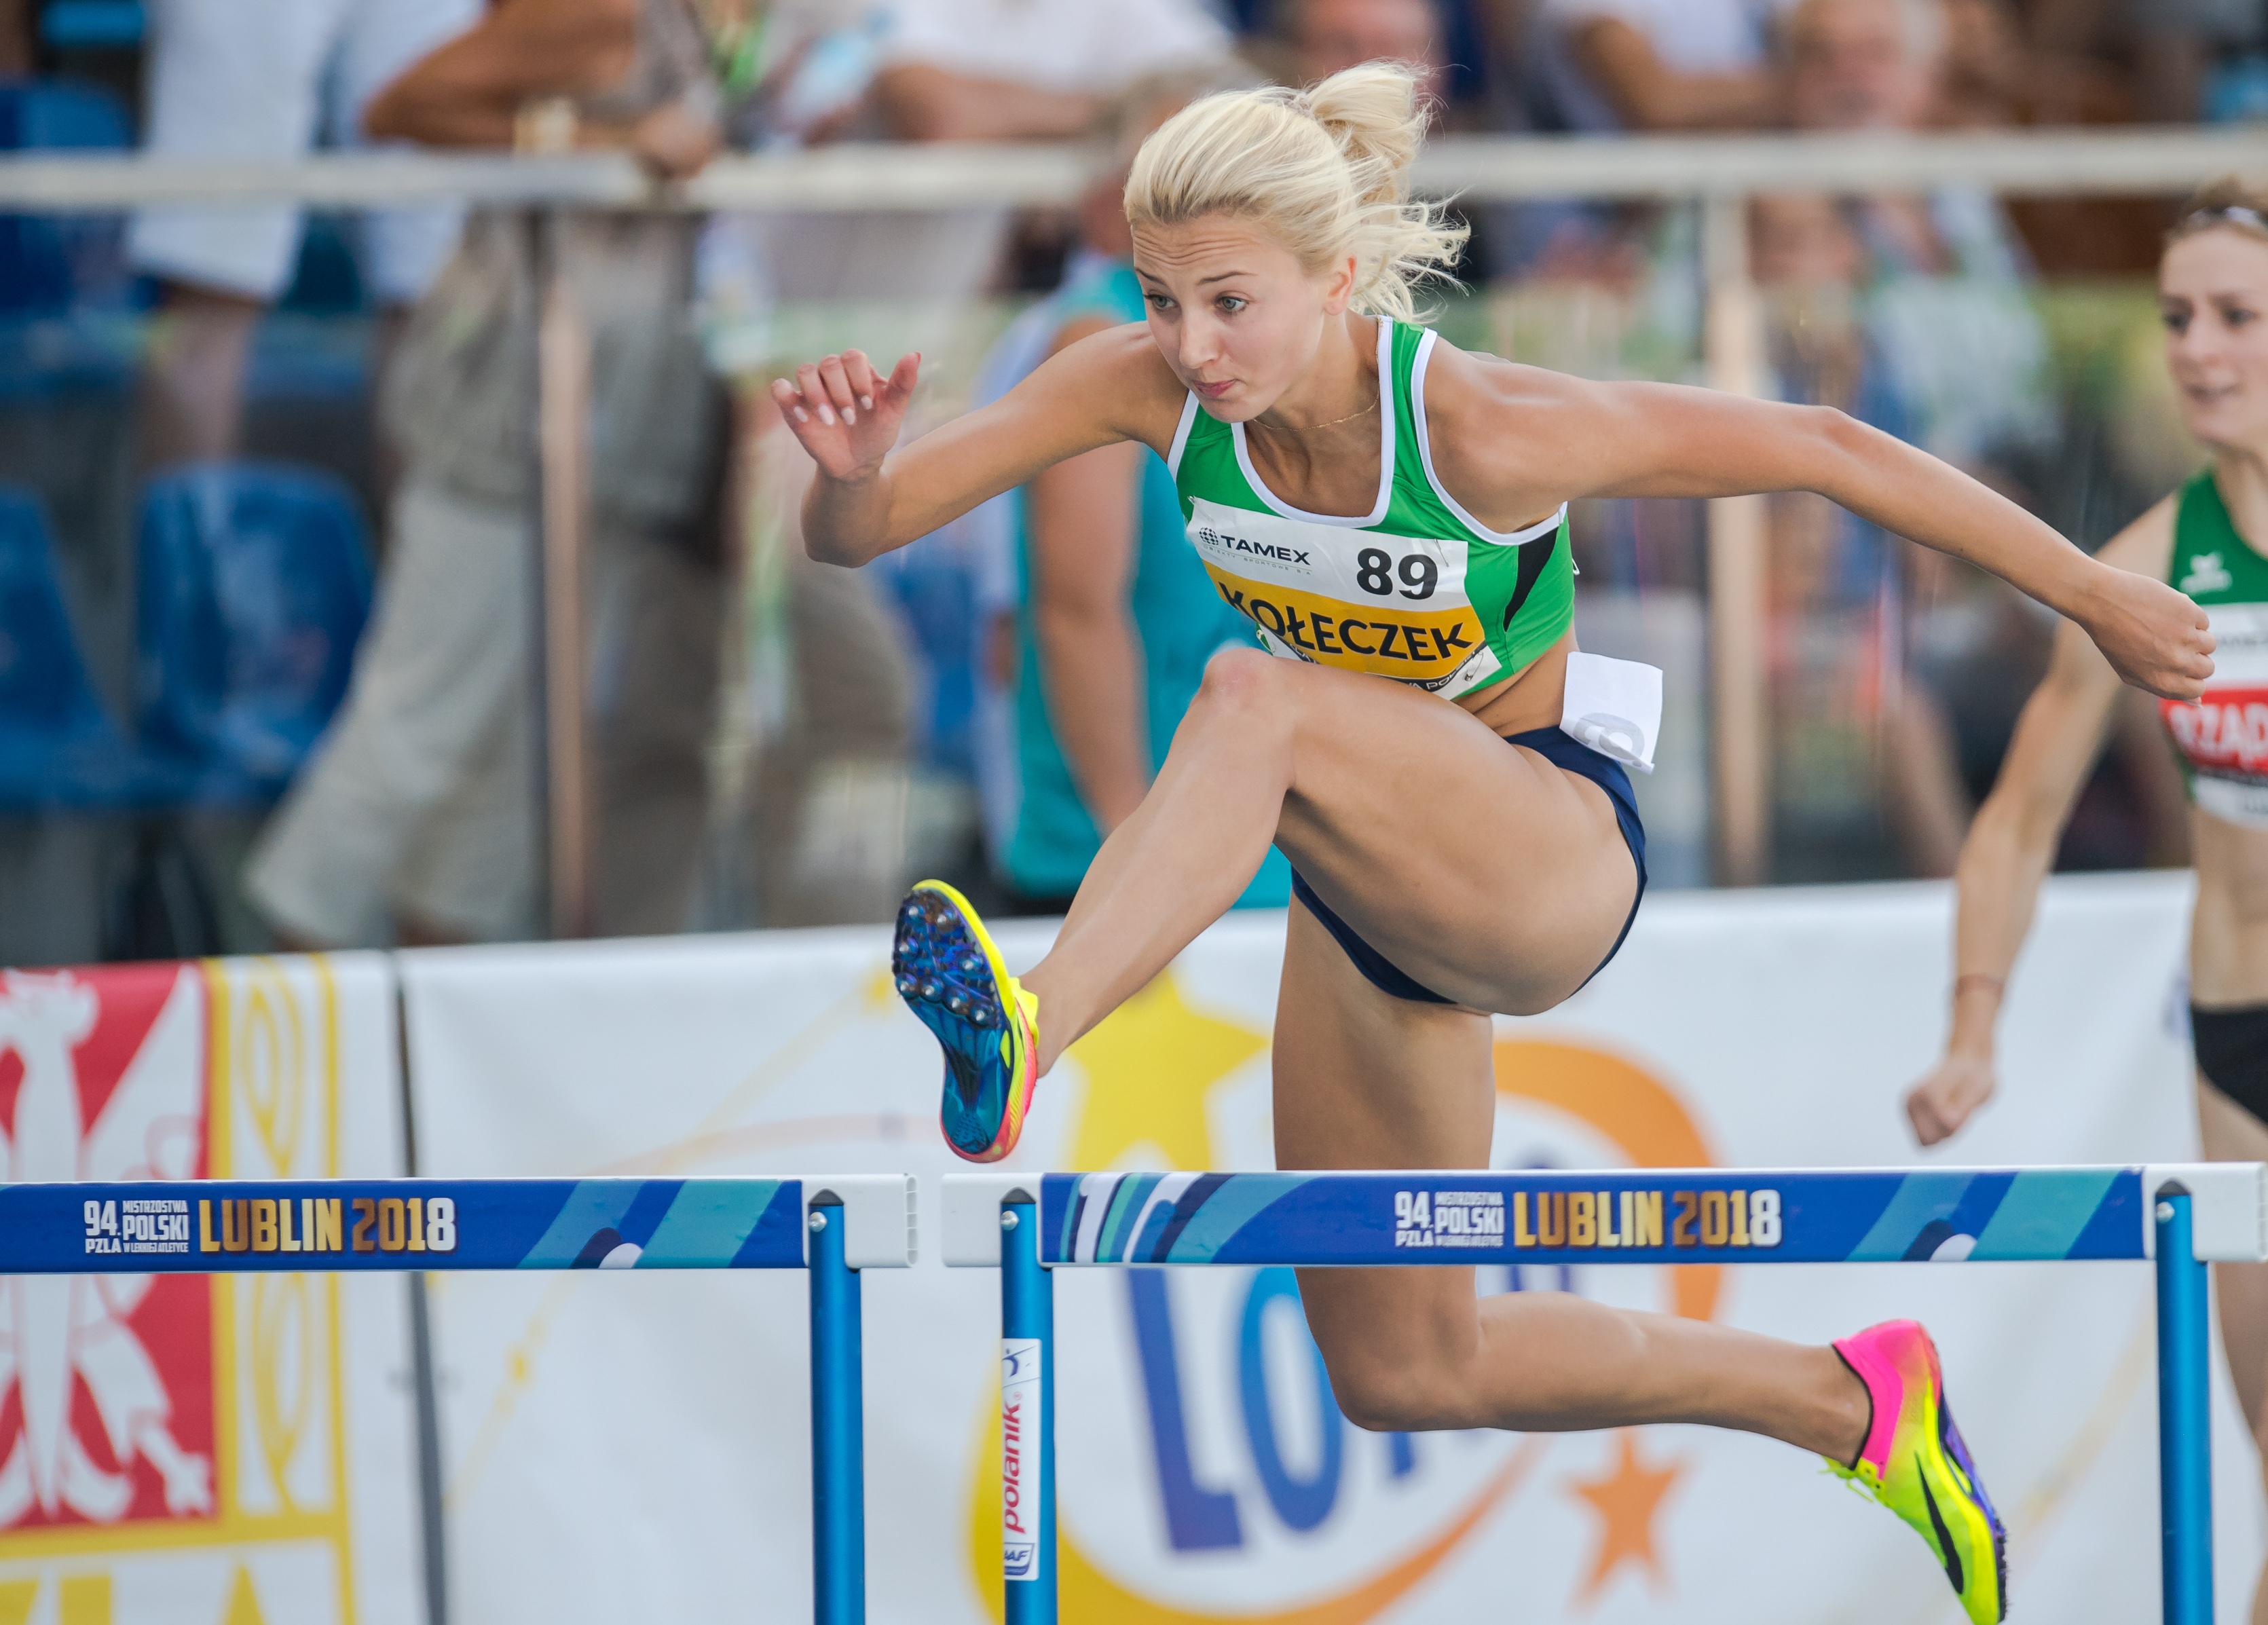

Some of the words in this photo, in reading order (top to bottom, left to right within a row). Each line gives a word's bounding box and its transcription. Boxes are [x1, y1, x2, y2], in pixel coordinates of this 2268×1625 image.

[1221, 535, 1311, 565] TAMEX
[1244, 557, 1289, 571] SPORTOWE
[1357, 547, 1438, 601] 89
[1218, 581, 1473, 661] KOŁECZEK
[83, 1200, 122, 1236] 94.
[122, 1214, 189, 1241] POLSKI
[198, 1198, 343, 1252] LUBLIN
[351, 1197, 457, 1252] 2018
[1434, 1206, 1505, 1235] POLSKI
[1513, 1191, 1663, 1247] LUBLIN
[1672, 1189, 1783, 1247] 2018
[85, 1237, 122, 1254] PZLA
[1395, 1230, 1434, 1247] PZLA
[1003, 1399, 1027, 1535] polanik
